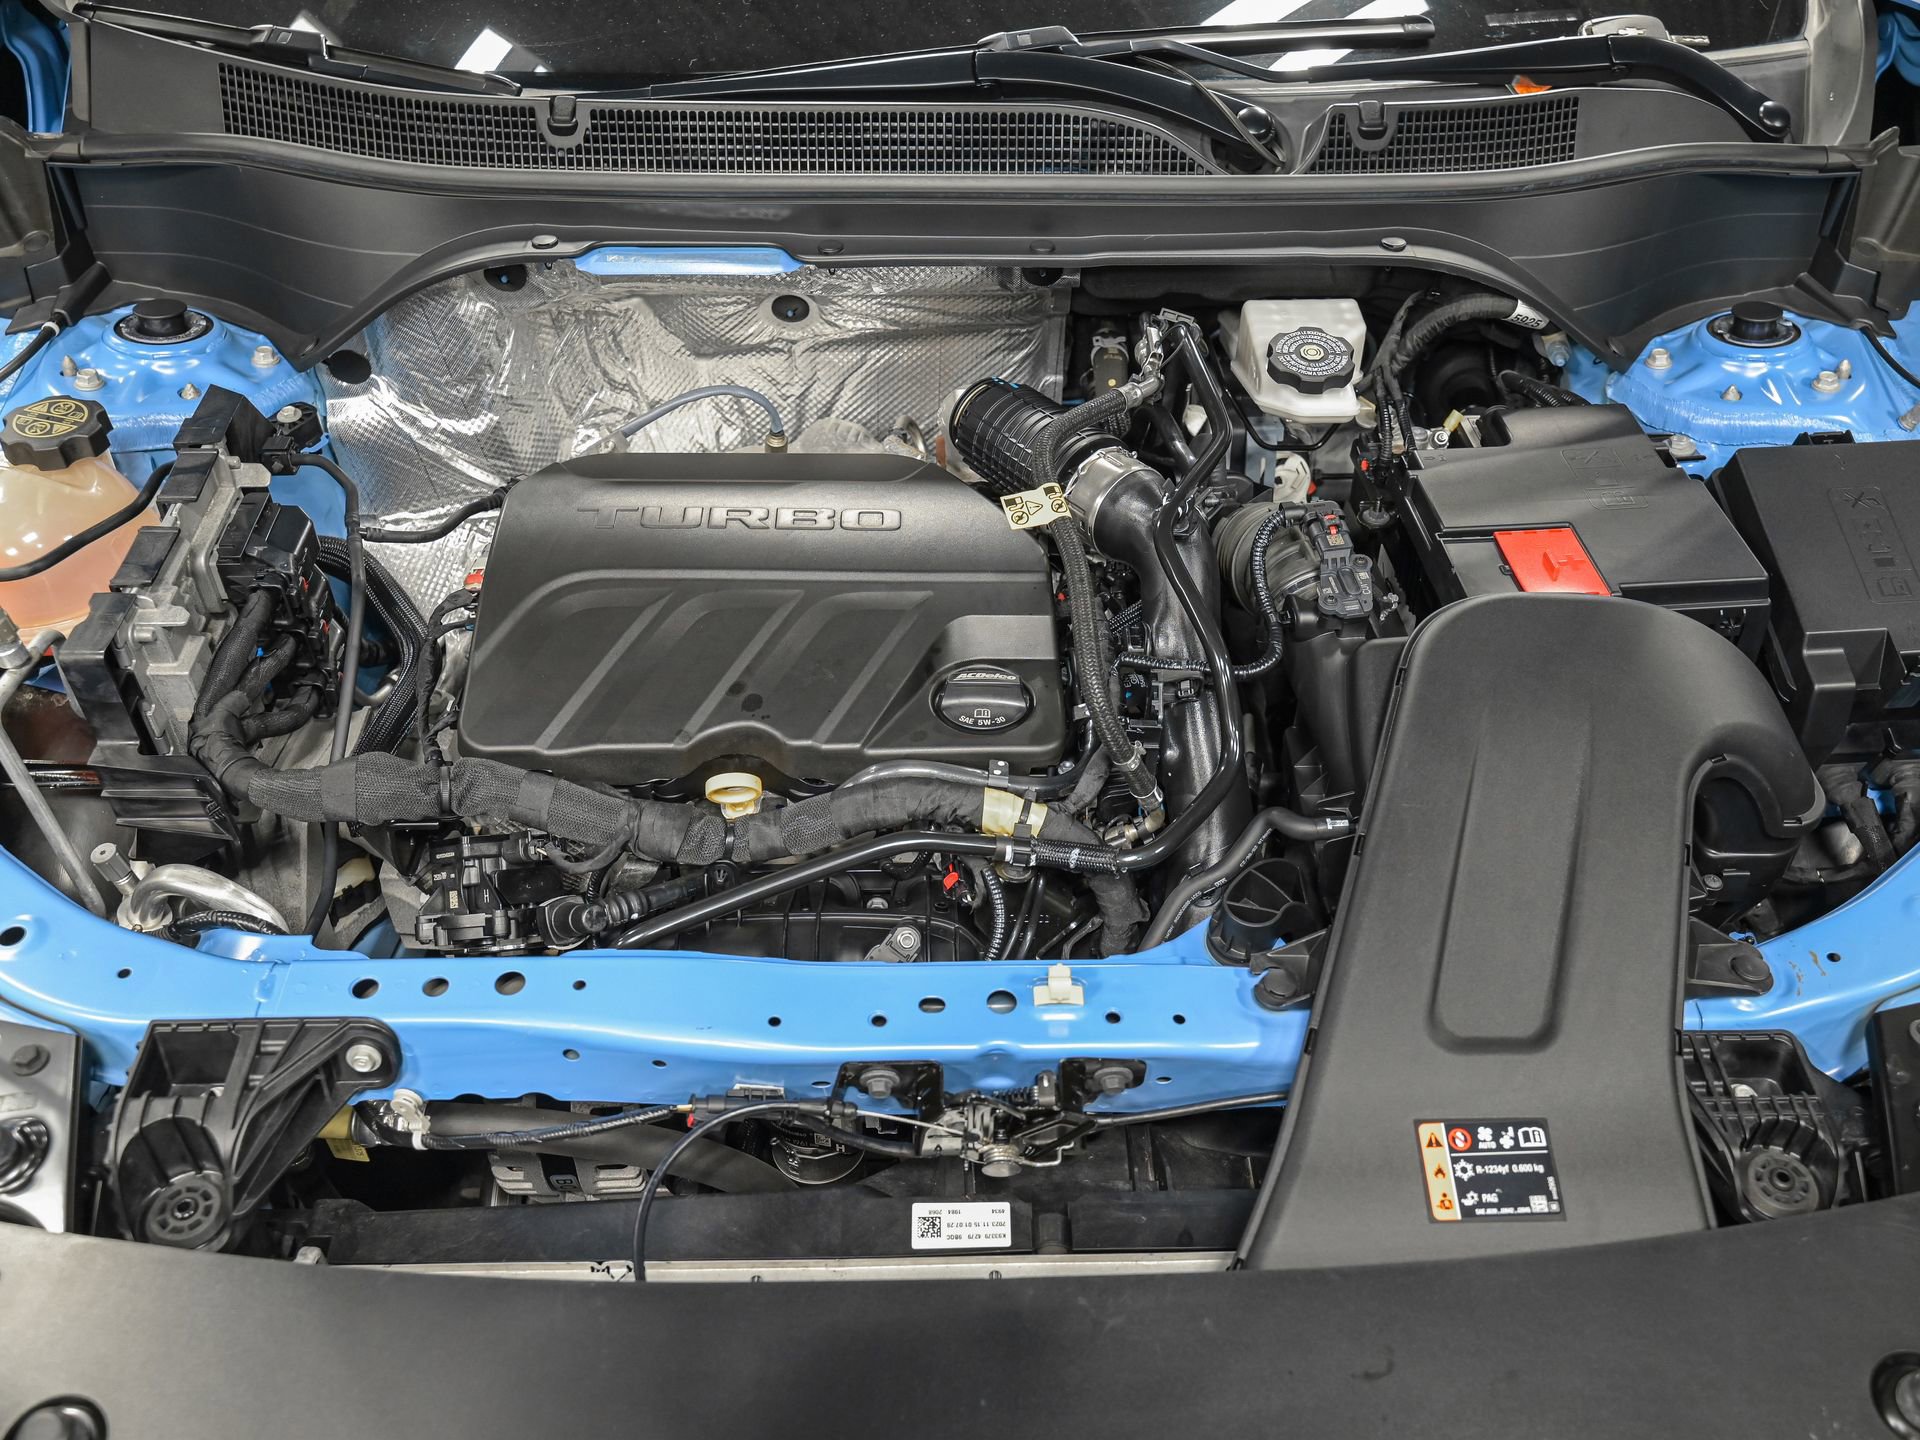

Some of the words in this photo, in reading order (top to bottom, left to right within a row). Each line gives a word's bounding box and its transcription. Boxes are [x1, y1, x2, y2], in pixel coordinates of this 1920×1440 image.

[576, 506, 902, 531] TURBO
[953, 672, 1017, 681] ACDelco
[958, 715, 975, 725] SAE
[977, 716, 1006, 726] 5W-30
[1478, 1141, 1497, 1149] AUTO
[1533, 1163, 1545, 1174] kg
[1481, 1193, 1499, 1203] PAG
